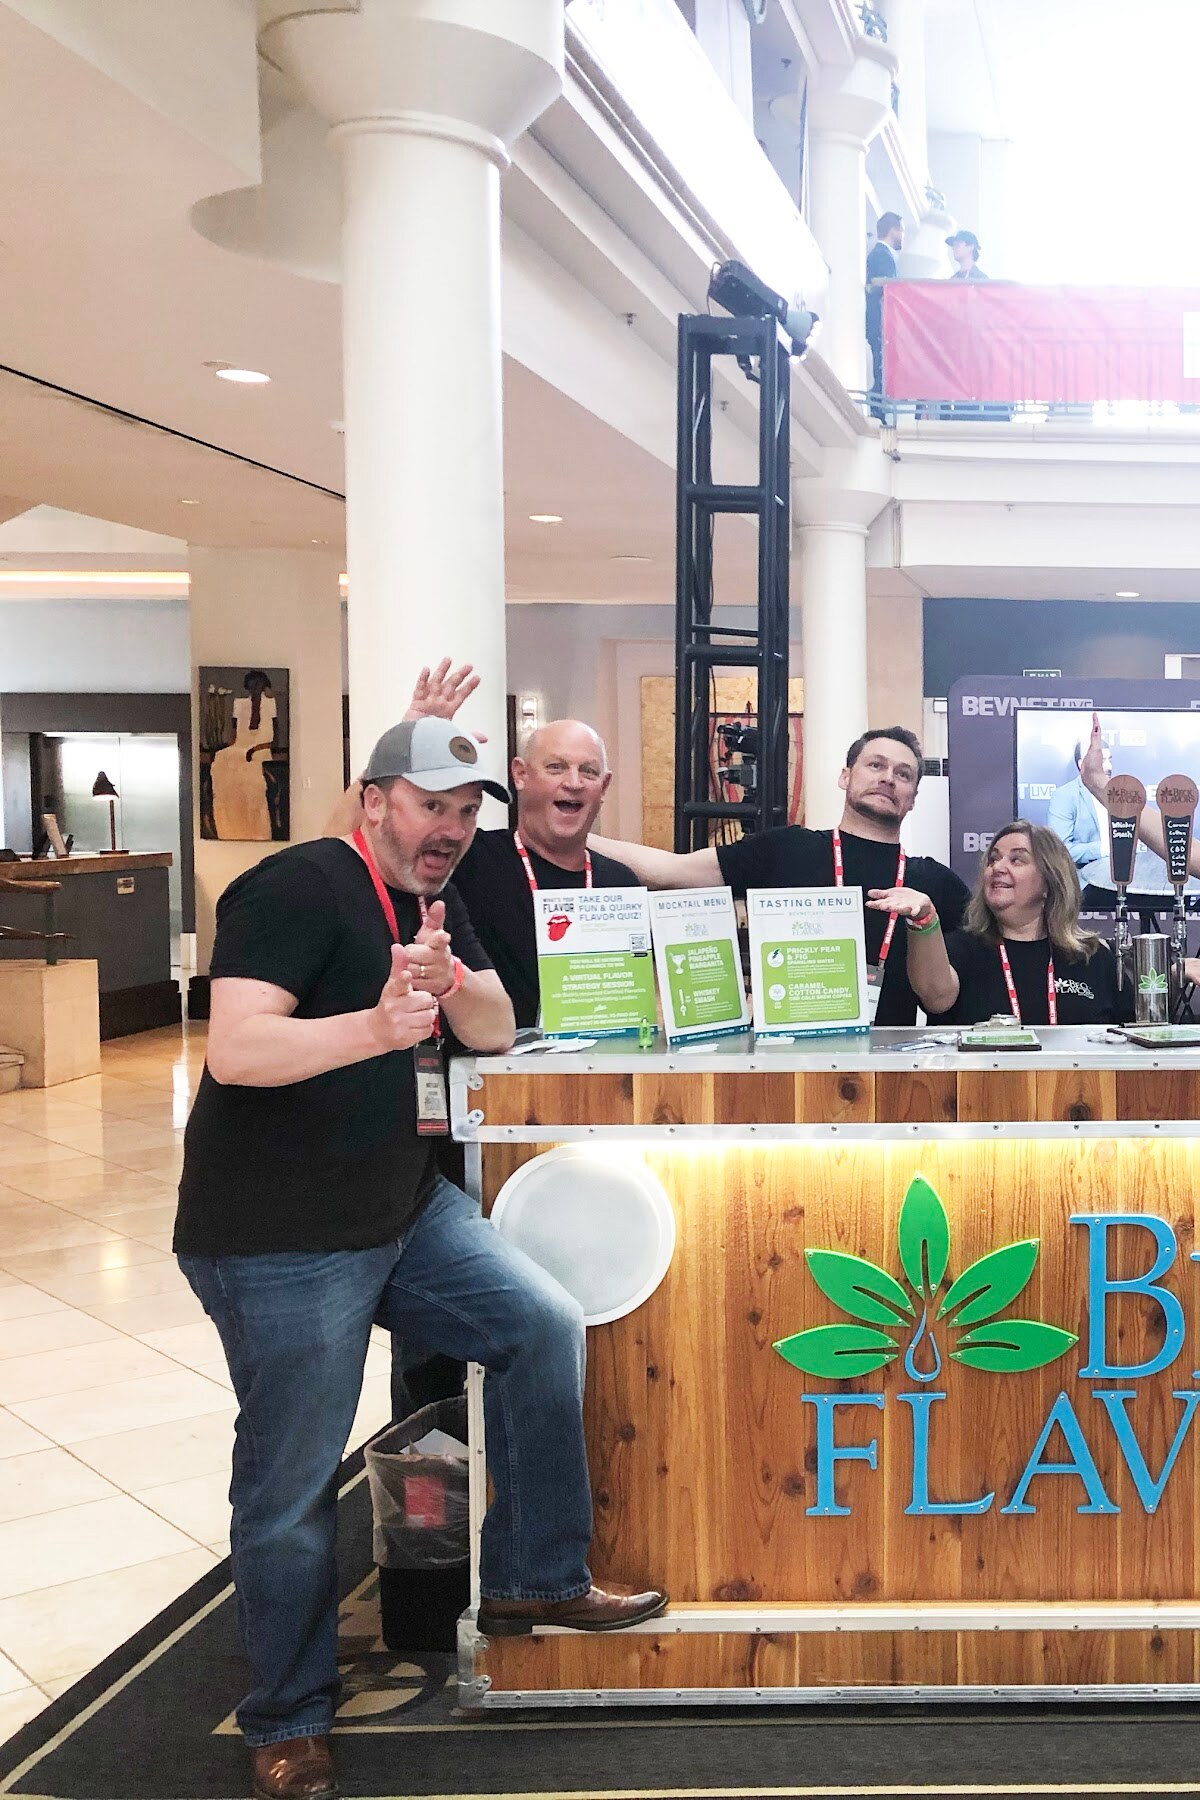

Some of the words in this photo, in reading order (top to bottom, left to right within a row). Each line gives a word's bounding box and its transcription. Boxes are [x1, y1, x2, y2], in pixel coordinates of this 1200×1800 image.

[604, 895, 623, 903] OUR
[760, 899, 812, 908] TASTING
[818, 898, 852, 906] MENU
[543, 903, 575, 914] FLAVOR
[579, 904, 598, 913] FUN
[609, 903, 643, 912] QUIRKY
[659, 901, 701, 910] MOCKTAIL
[704, 899, 727, 907] MENU
[580, 913, 616, 921] FLAVOR
[693, 988, 721, 997] WHISKEY
[823, 987, 849, 995] CANDY
